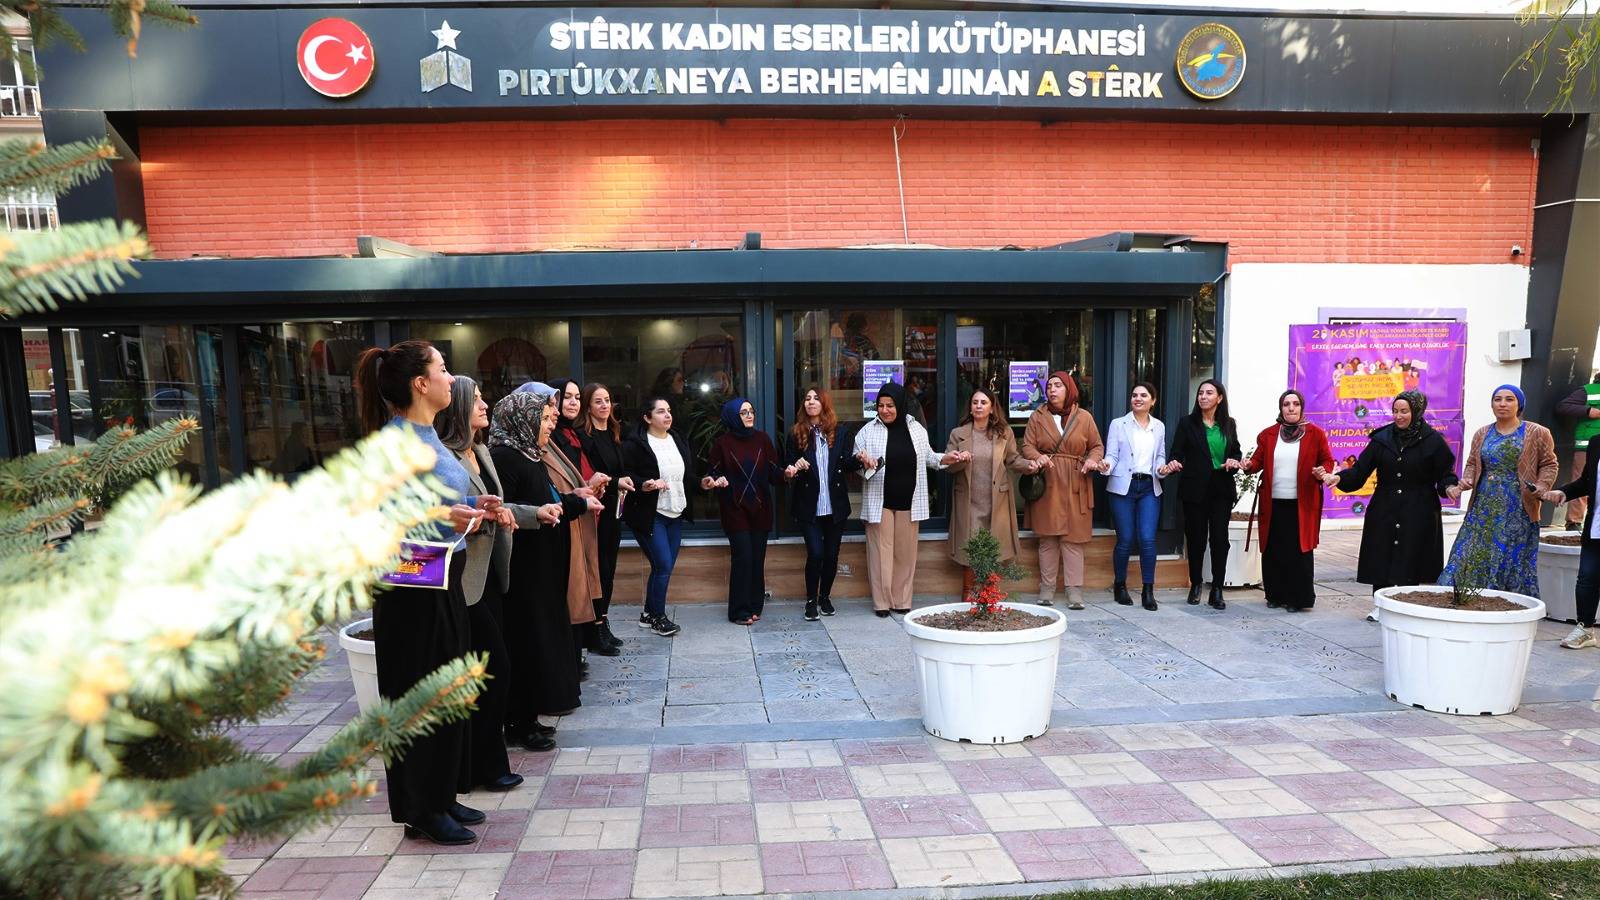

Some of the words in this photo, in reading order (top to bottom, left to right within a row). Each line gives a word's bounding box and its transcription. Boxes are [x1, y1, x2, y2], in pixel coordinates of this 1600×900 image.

[550, 16, 654, 51] STÊRK
[662, 22, 765, 51] KADIN
[774, 20, 920, 53] ESERLERİ
[928, 20, 1146, 56] KÜTÜPHANESİ
[498, 62, 753, 96] PIRTÛKXANEYA
[760, 61, 930, 95] BERHEMÊN
[937, 68, 1030, 96] JINAN
[1036, 70, 1062, 97] A
[1068, 64, 1164, 98] STÊRK
[1331, 328, 1369, 338] KASIM
